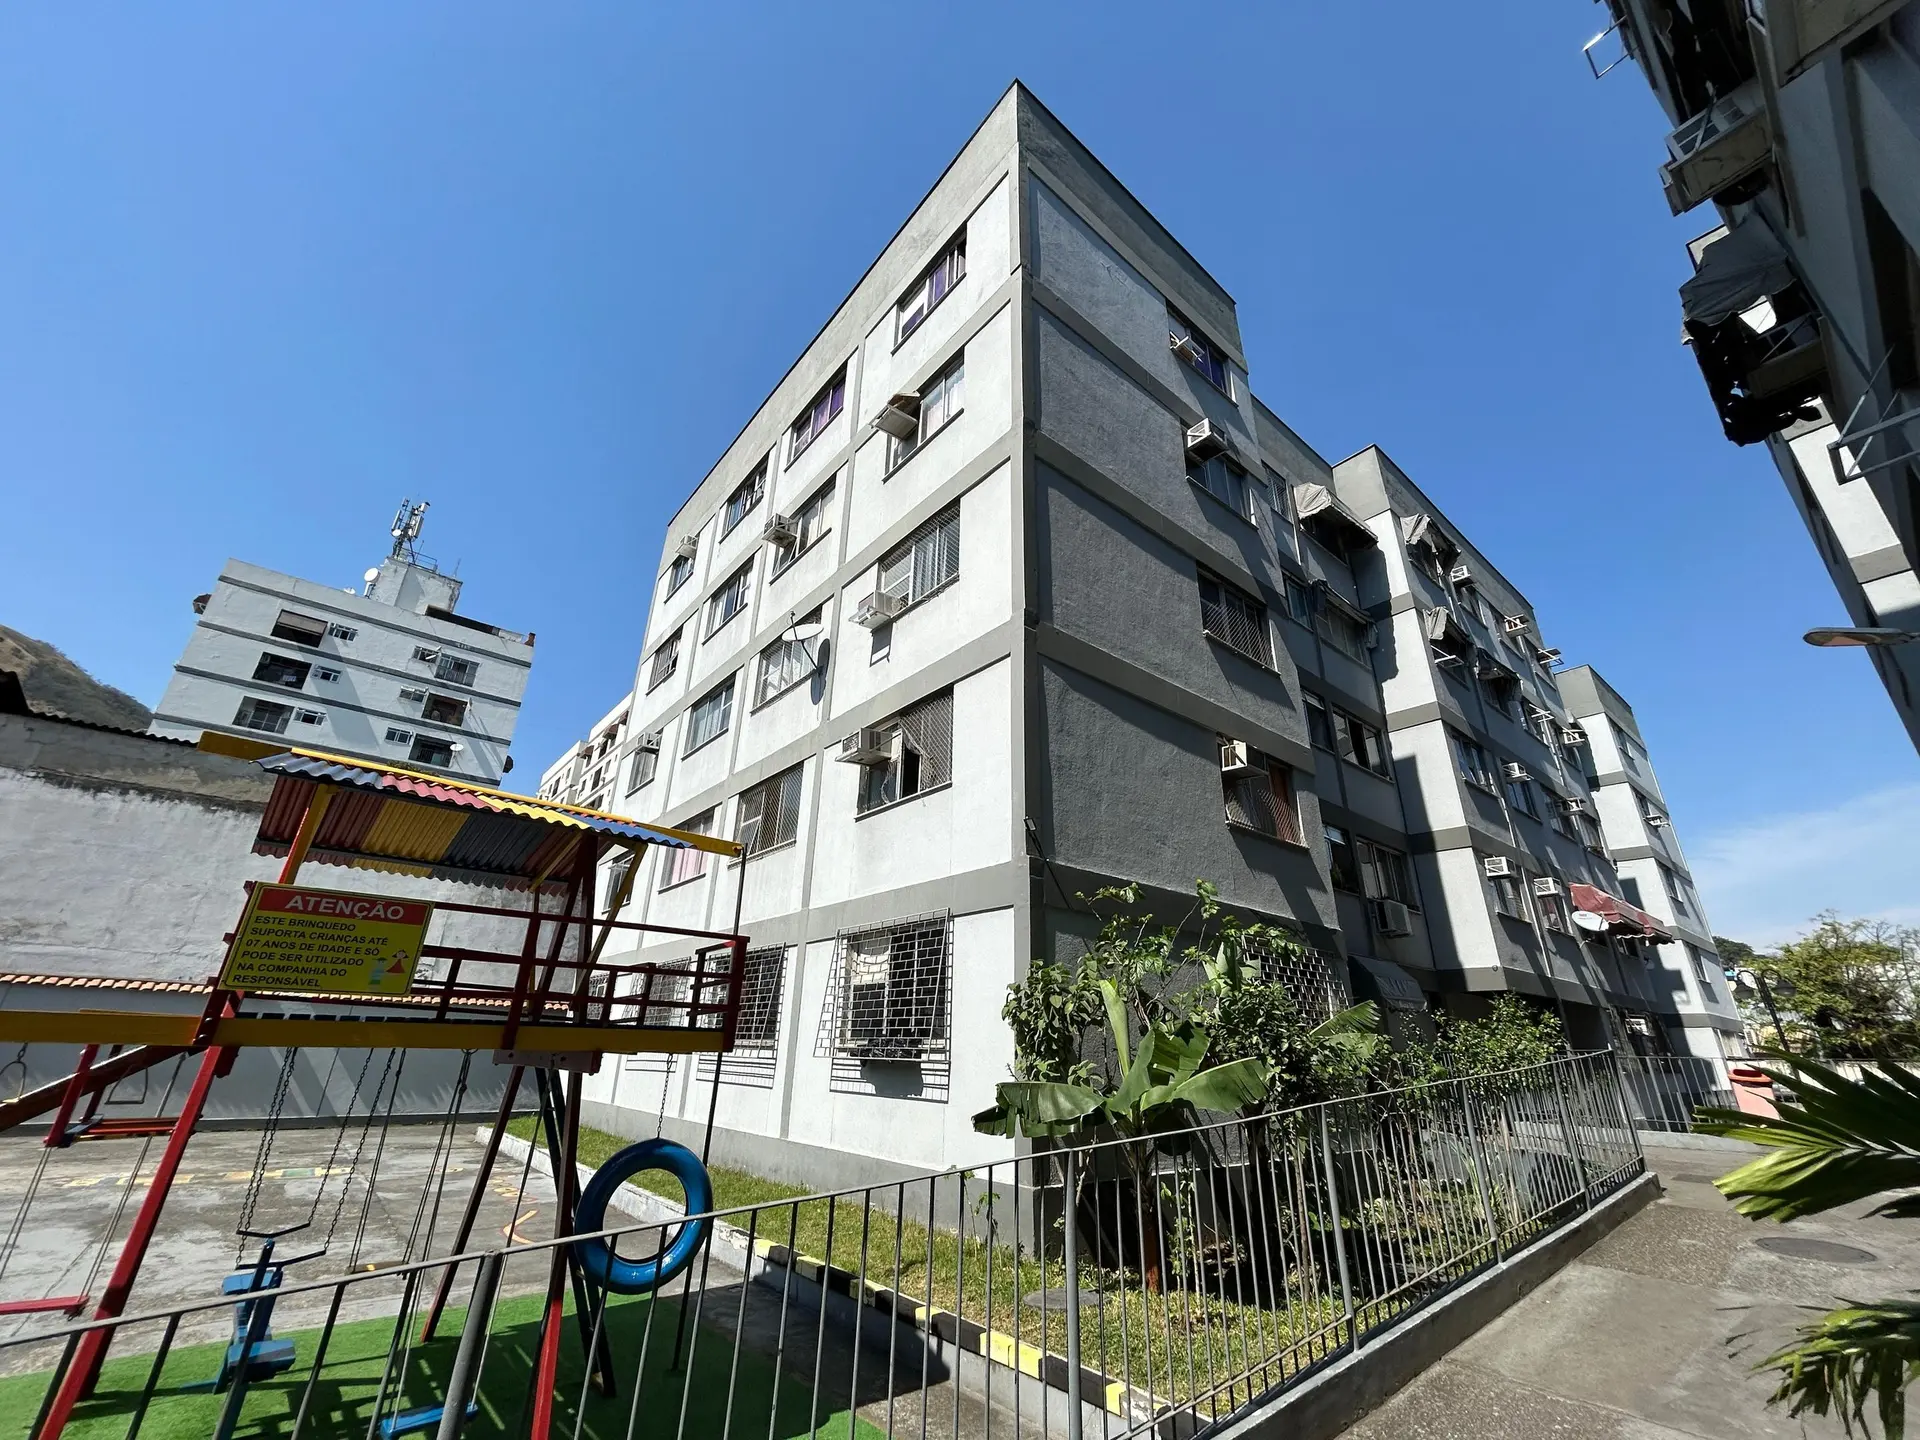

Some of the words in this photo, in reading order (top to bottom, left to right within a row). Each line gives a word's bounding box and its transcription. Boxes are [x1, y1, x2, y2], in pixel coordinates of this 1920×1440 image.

[285, 896, 403, 920] ATENÇÃO
[255, 916, 285, 925] ESTE
[288, 919, 356, 931] BRINQUEDO
[251, 928, 305, 939] SUPORTA
[309, 932, 366, 944] CRIANÇAS
[246, 939, 259, 947] 07
[260, 940, 296, 950] ANOS
[299, 942, 314, 951] DE
[317, 944, 352, 954] IDADE
[364, 947, 379, 956] SÓ
[241, 951, 276, 960] PODE
[279, 953, 303, 962] SER
[306, 955, 364, 966] UTILIZADO
[237, 962, 254, 971] NA
[257, 964, 327, 975] COMPANHIA
[330, 968, 347, 976] DO
[233, 974, 320, 986] RESPONSÁVEL
